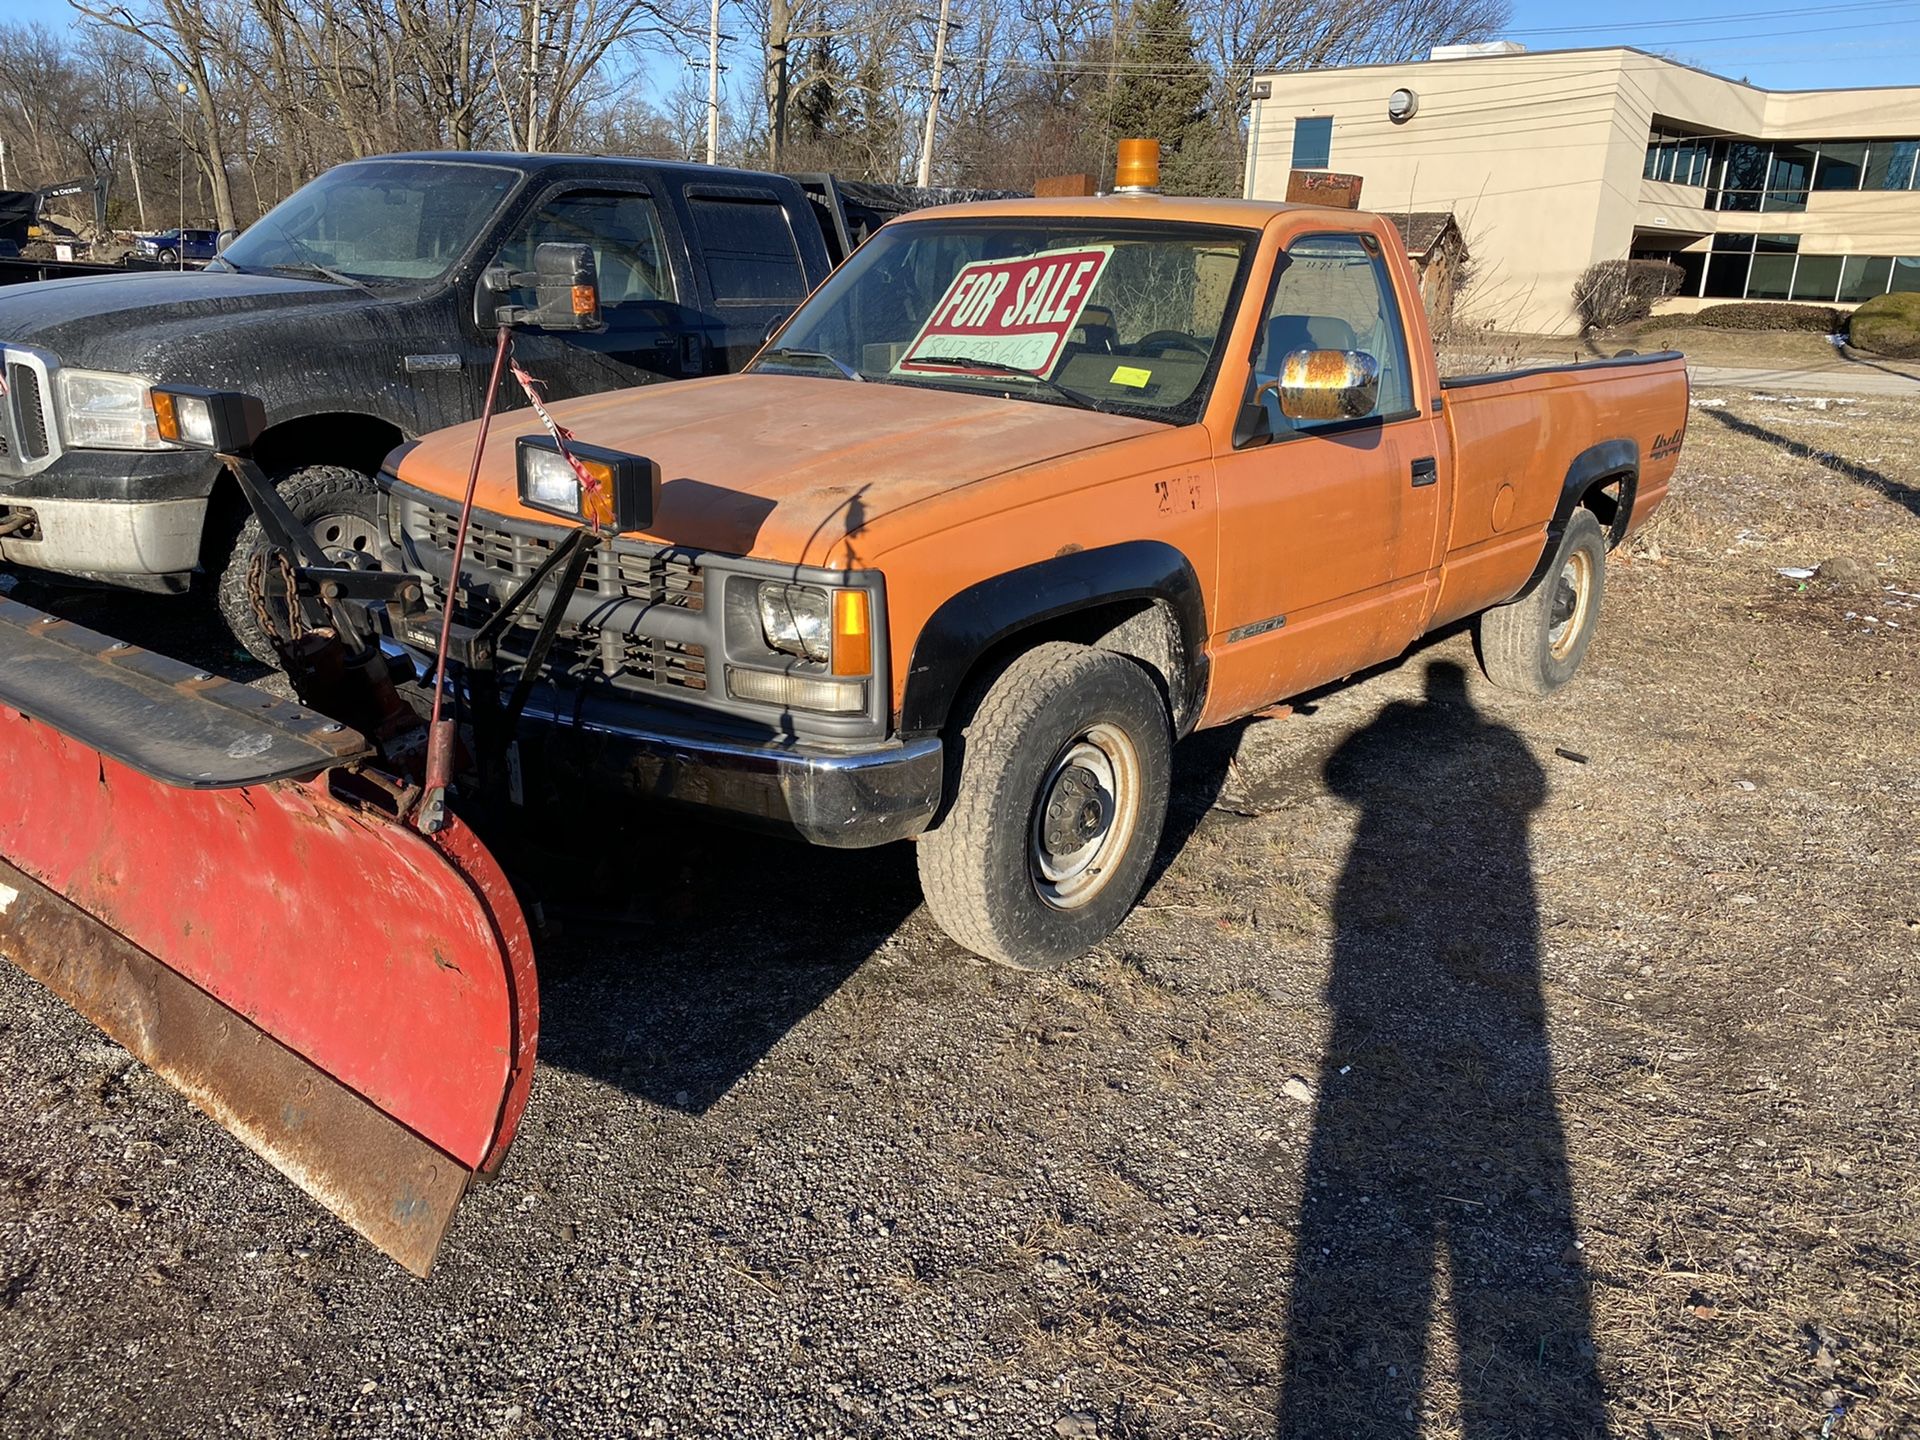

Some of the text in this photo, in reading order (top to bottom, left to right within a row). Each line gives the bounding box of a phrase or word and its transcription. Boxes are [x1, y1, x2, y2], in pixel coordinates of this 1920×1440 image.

[59, 187, 82, 195] DEERE
[934, 261, 1095, 328] FOR SALE
